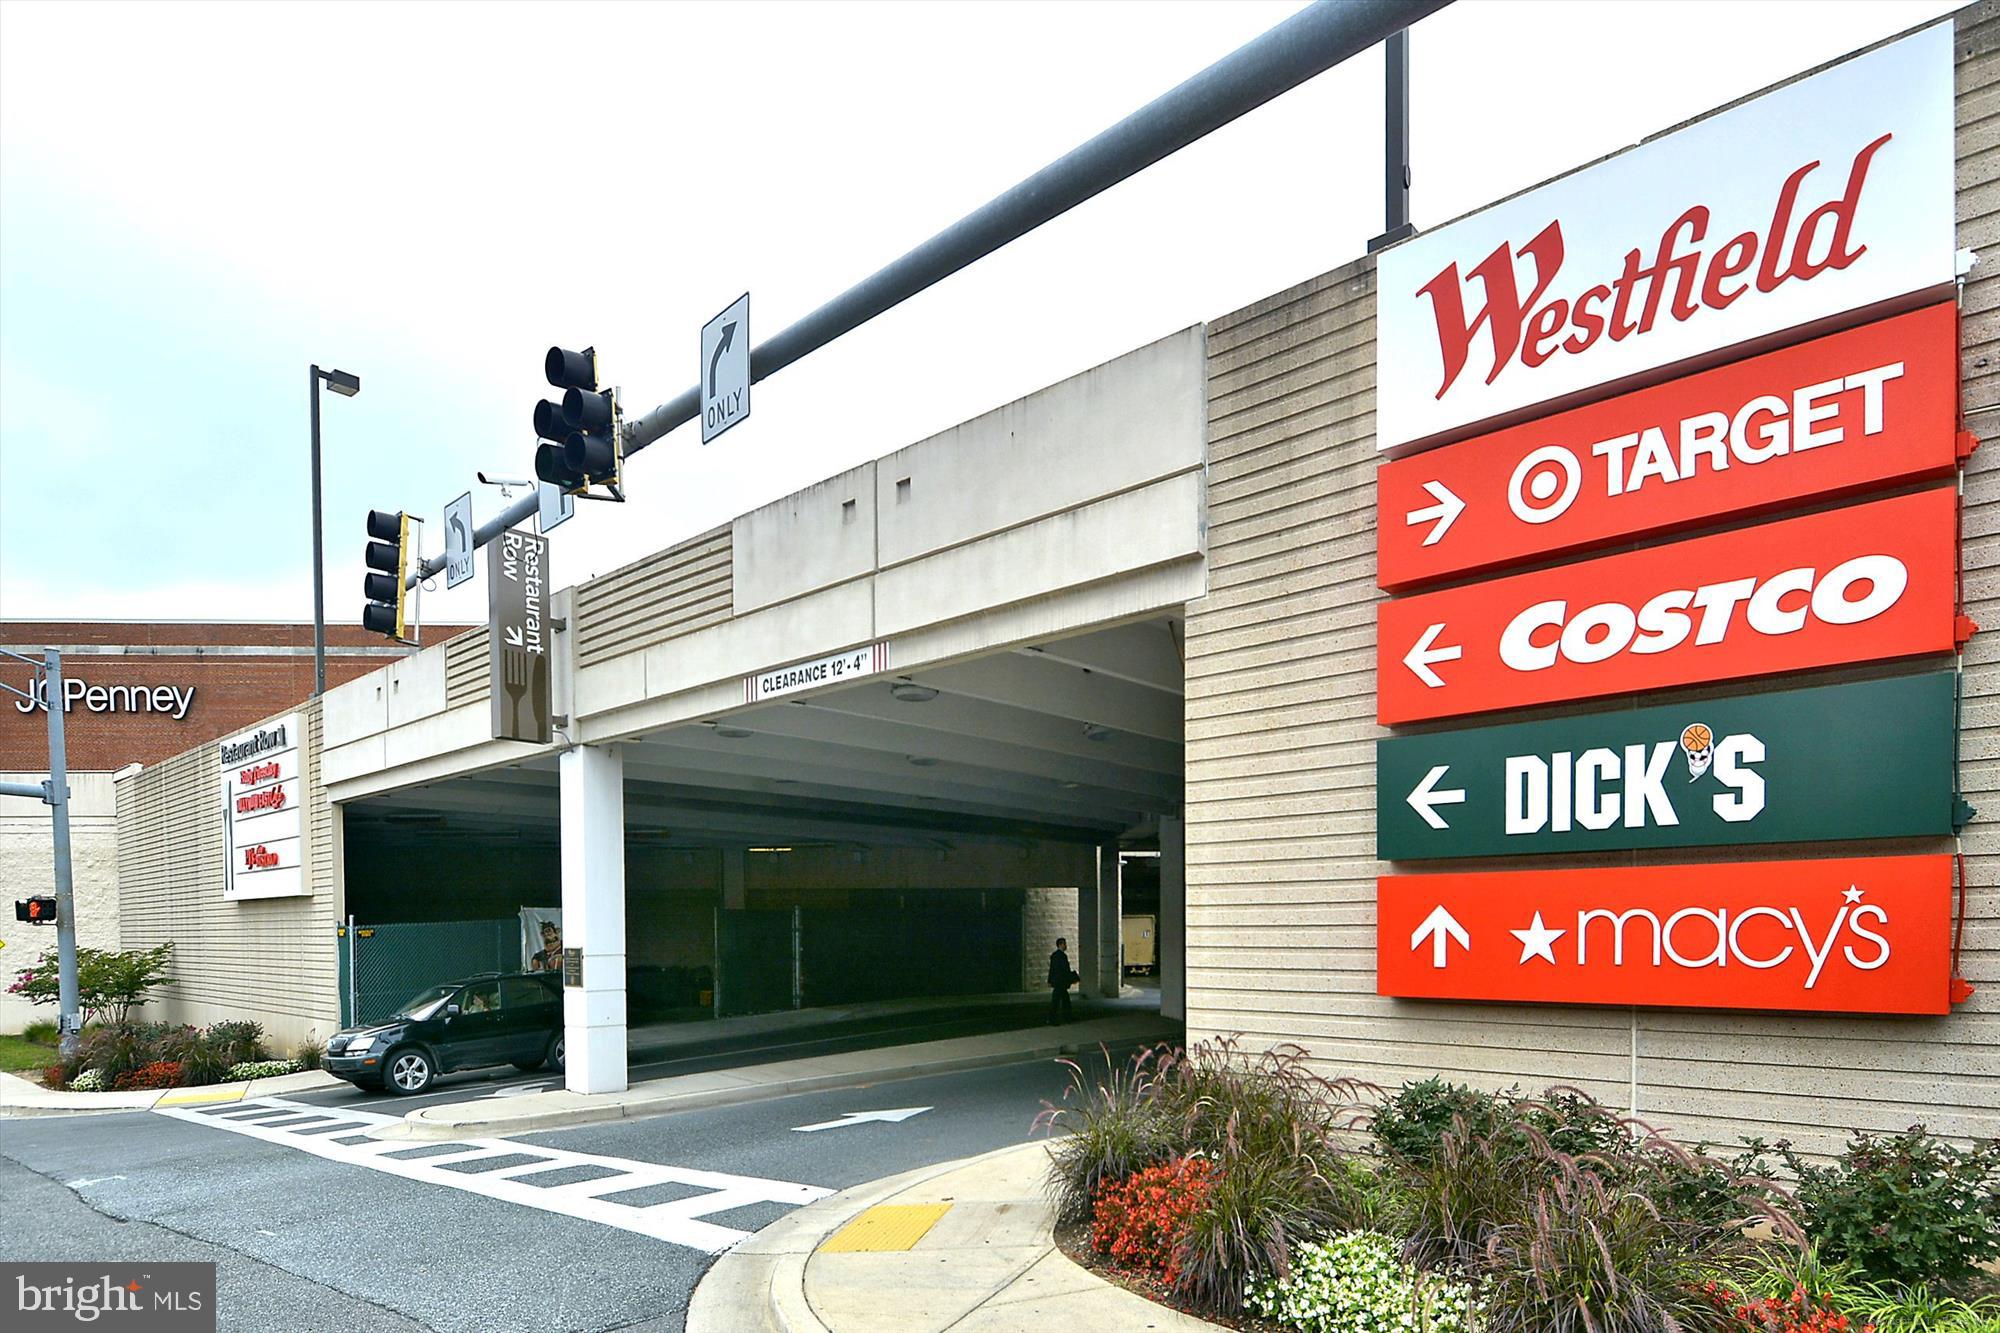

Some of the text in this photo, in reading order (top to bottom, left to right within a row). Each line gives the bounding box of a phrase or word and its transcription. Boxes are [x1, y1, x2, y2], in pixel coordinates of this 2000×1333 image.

[1415, 132, 1892, 400] Westfield
[707, 386, 742, 429] ONLY
[1592, 361, 1905, 497] TARGET
[449, 556, 470, 580] ONLY
[503, 531, 522, 582] Row
[524, 537, 544, 654] Restaurant
[1499, 554, 1908, 671] COSTCO
[762, 664, 827, 693] CLEARANCE
[1505, 722, 1766, 835] DICK'S
[1577, 883, 1891, 989] macy's
